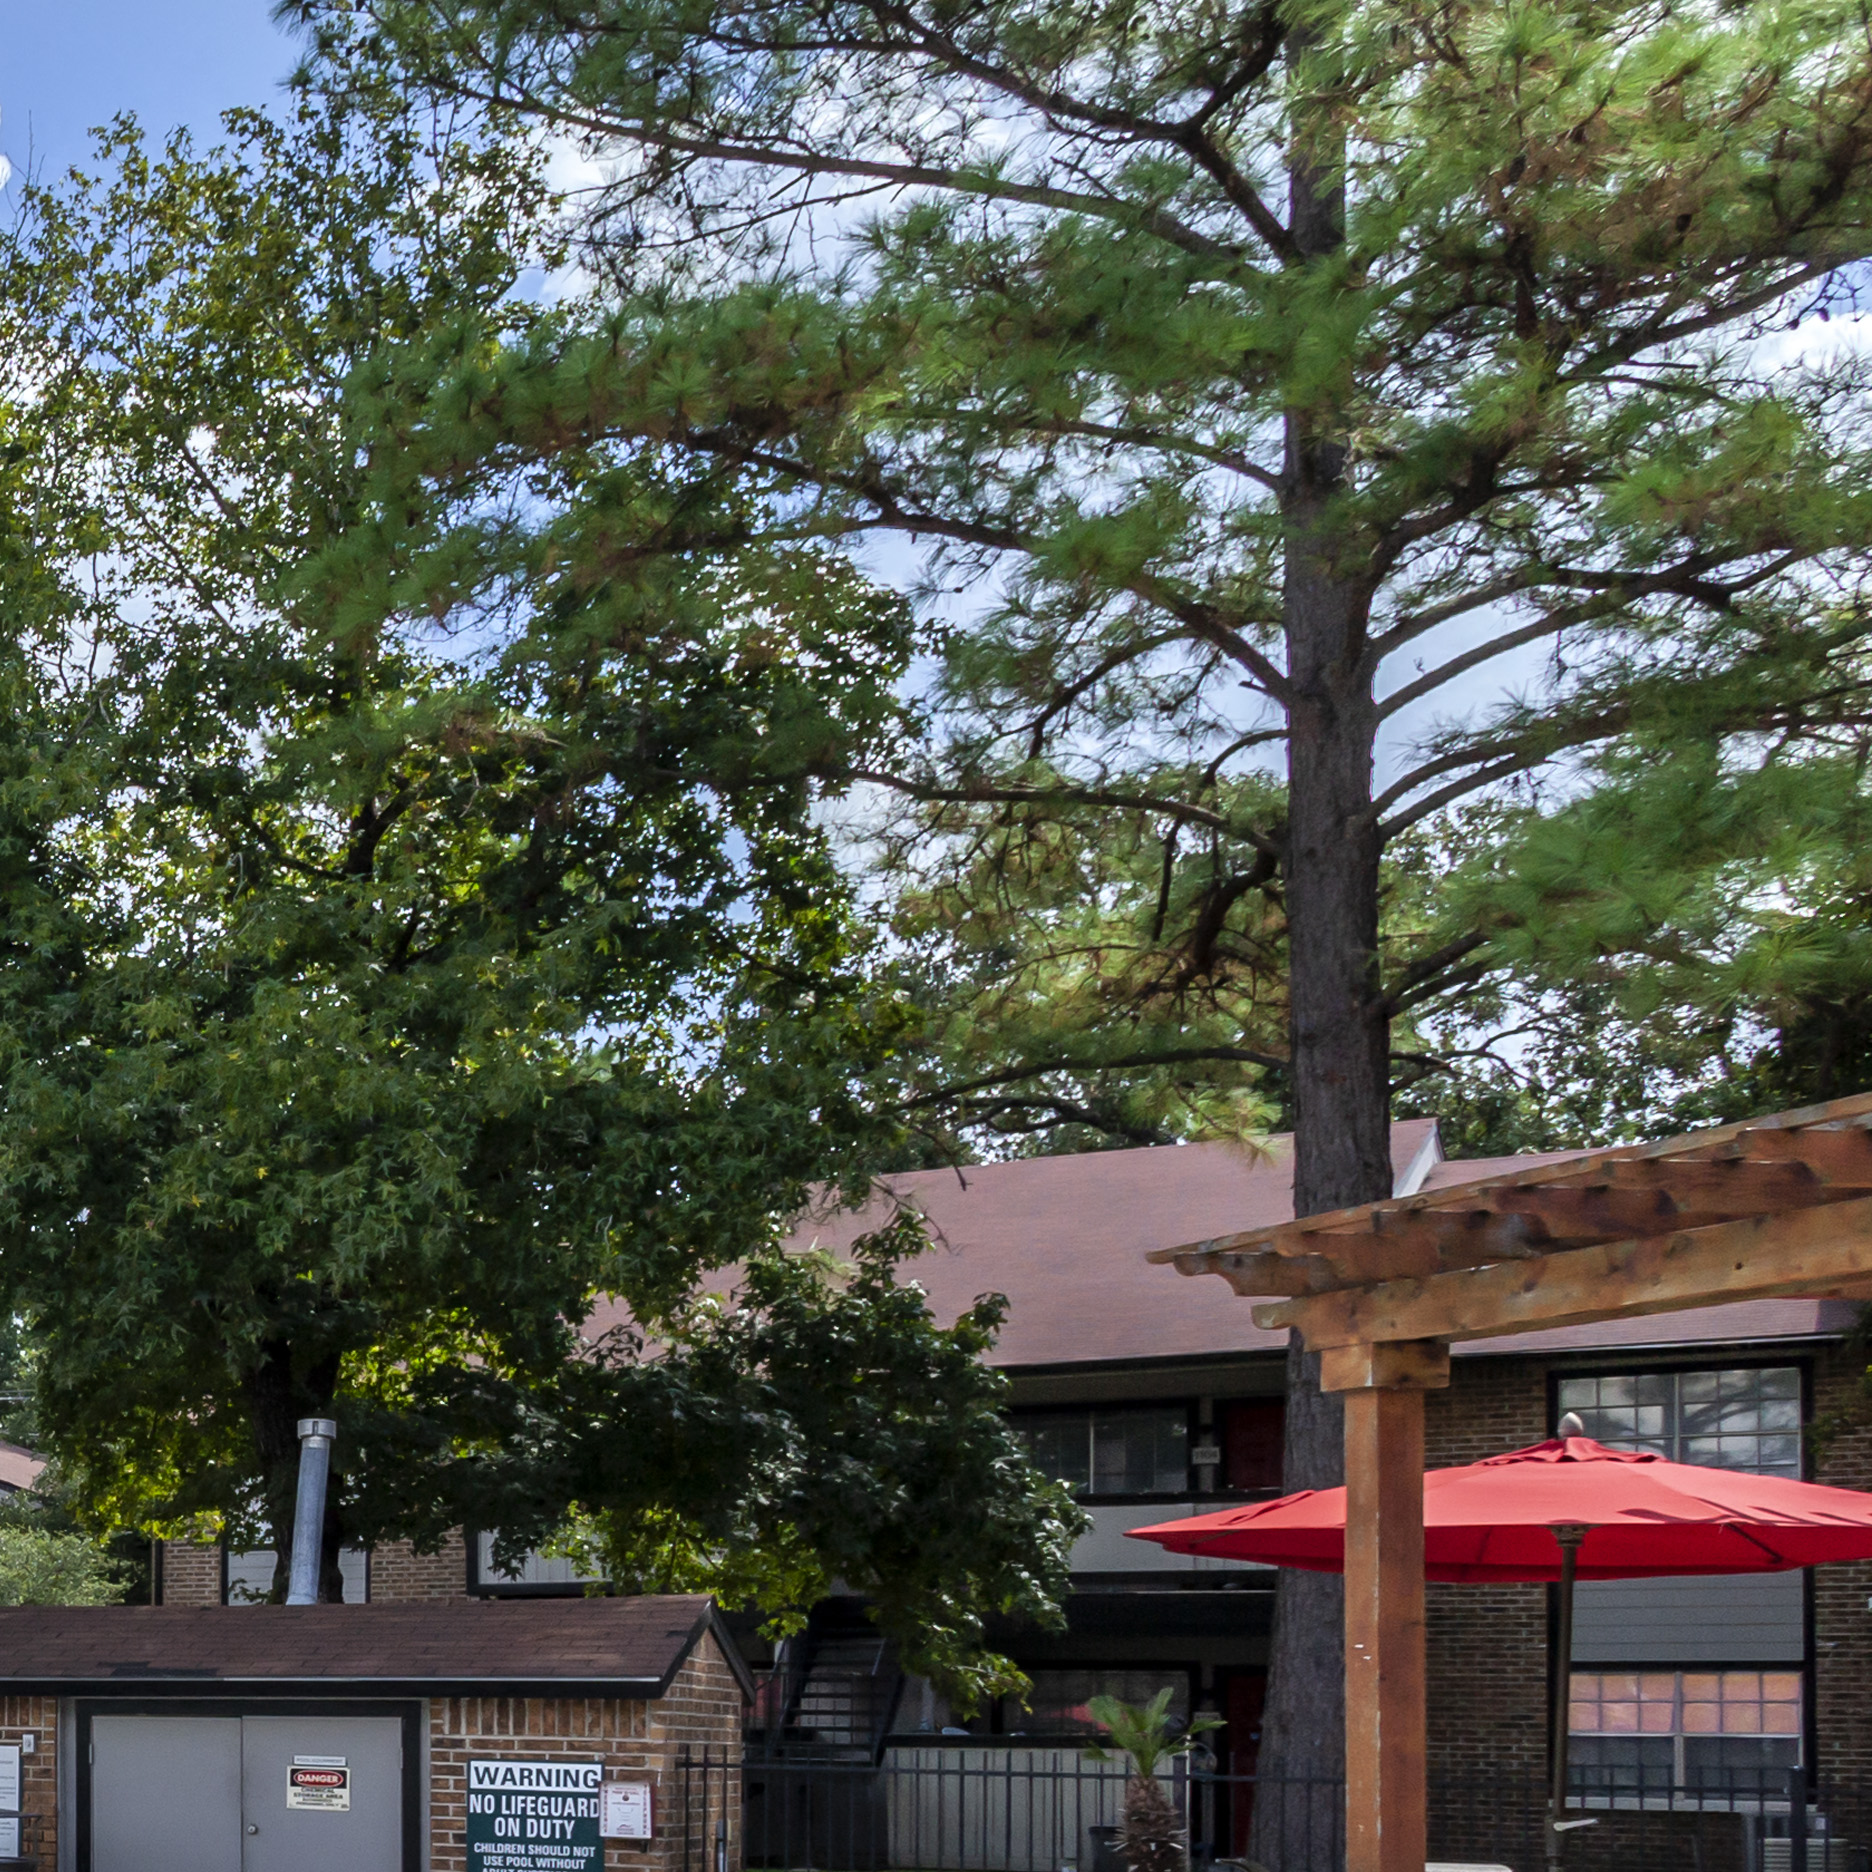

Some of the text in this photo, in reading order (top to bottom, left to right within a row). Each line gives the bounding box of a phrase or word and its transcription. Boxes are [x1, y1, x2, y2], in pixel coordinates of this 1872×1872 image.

[297, 1774, 338, 1783] DANGER
[474, 1766, 598, 1789] WARNING
[469, 1794, 495, 1814] NO
[501, 1795, 600, 1818] LIFEGUARD
[494, 1817, 576, 1839] ON DUTY
[474, 1842, 596, 1858] CHILDREN SHOULD NOT
[483, 1855, 586, 1870] USE POOL WITHOUT
